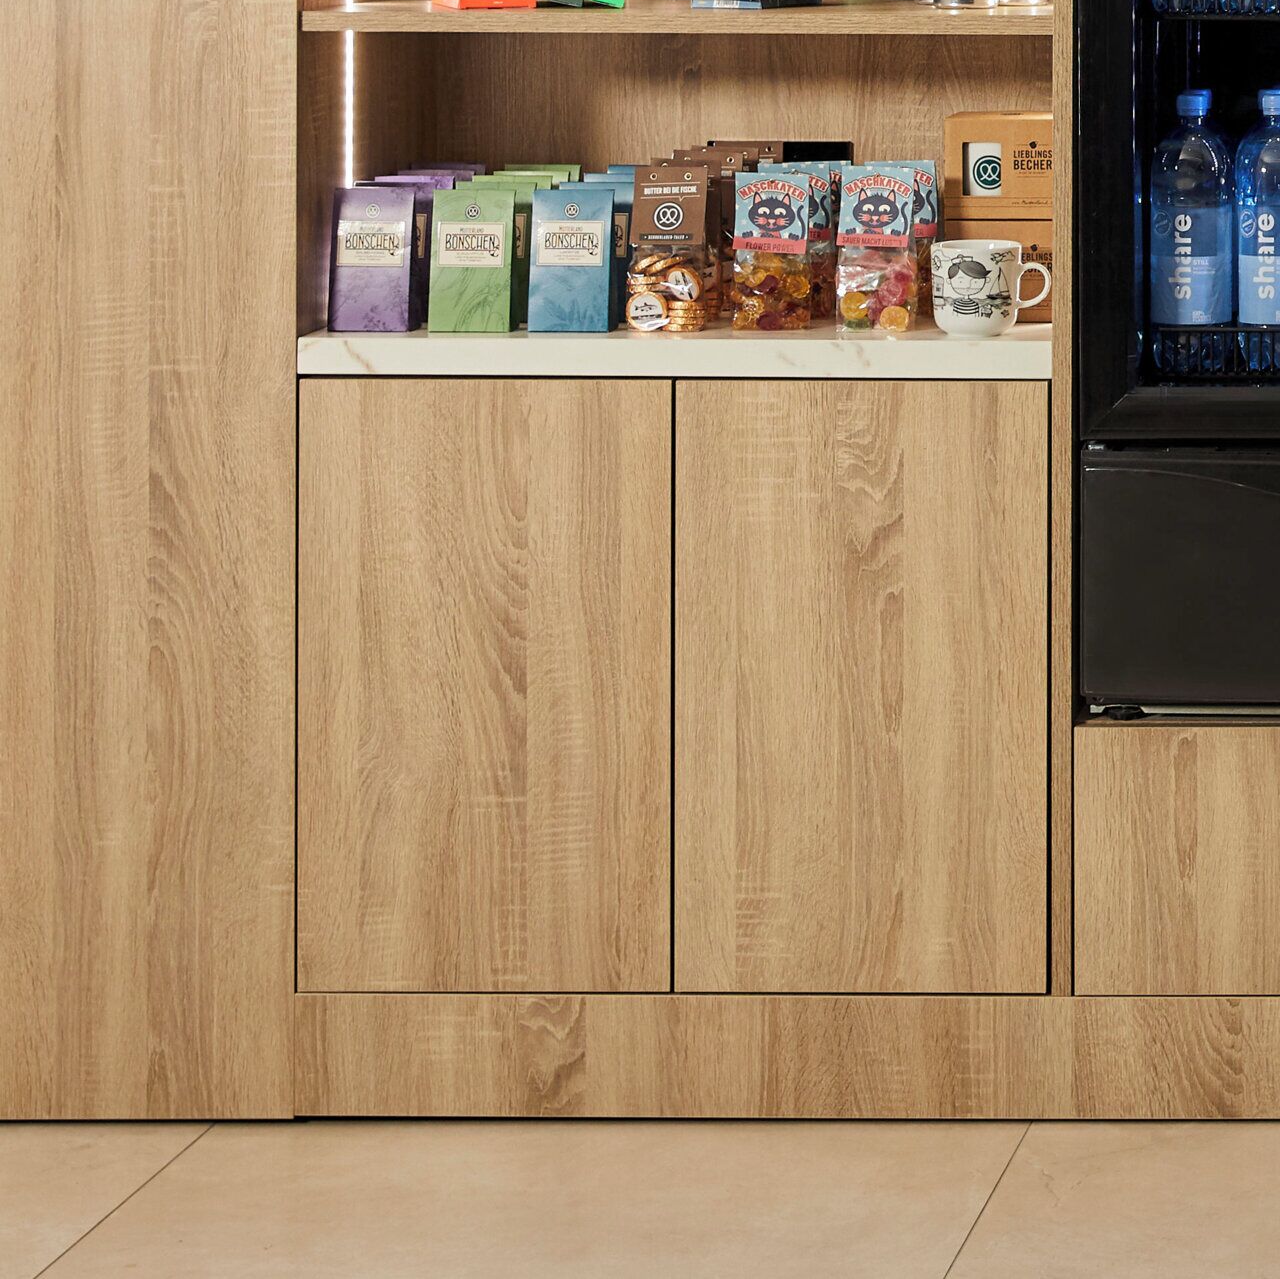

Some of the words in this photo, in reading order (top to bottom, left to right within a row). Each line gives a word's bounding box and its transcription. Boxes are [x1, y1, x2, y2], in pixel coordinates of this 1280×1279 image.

[1013, 150, 1053, 159] LIEBLINGS
[1013, 160, 1053, 170] BECHER
[644, 187, 662, 195] BUTTER
[663, 186, 671, 195] BEI
[671, 186, 680, 194] DIE
[680, 185, 697, 193] FISCHE
[738, 180, 806, 201] NASCHKATER
[844, 175, 912, 198] NASCHKATER
[345, 233, 396, 250] BONSCHEN
[445, 234, 497, 251] BONSCHEN
[545, 232, 595, 249] BONSCHEN
[745, 241, 771, 251] FLOWER
[772, 243, 795, 252] POWER
[842, 236, 861, 244] SAUER
[1022, 252, 1053, 261] EBLINGS
[1168, 213, 1192, 300] share
[1253, 213, 1275, 300] share
